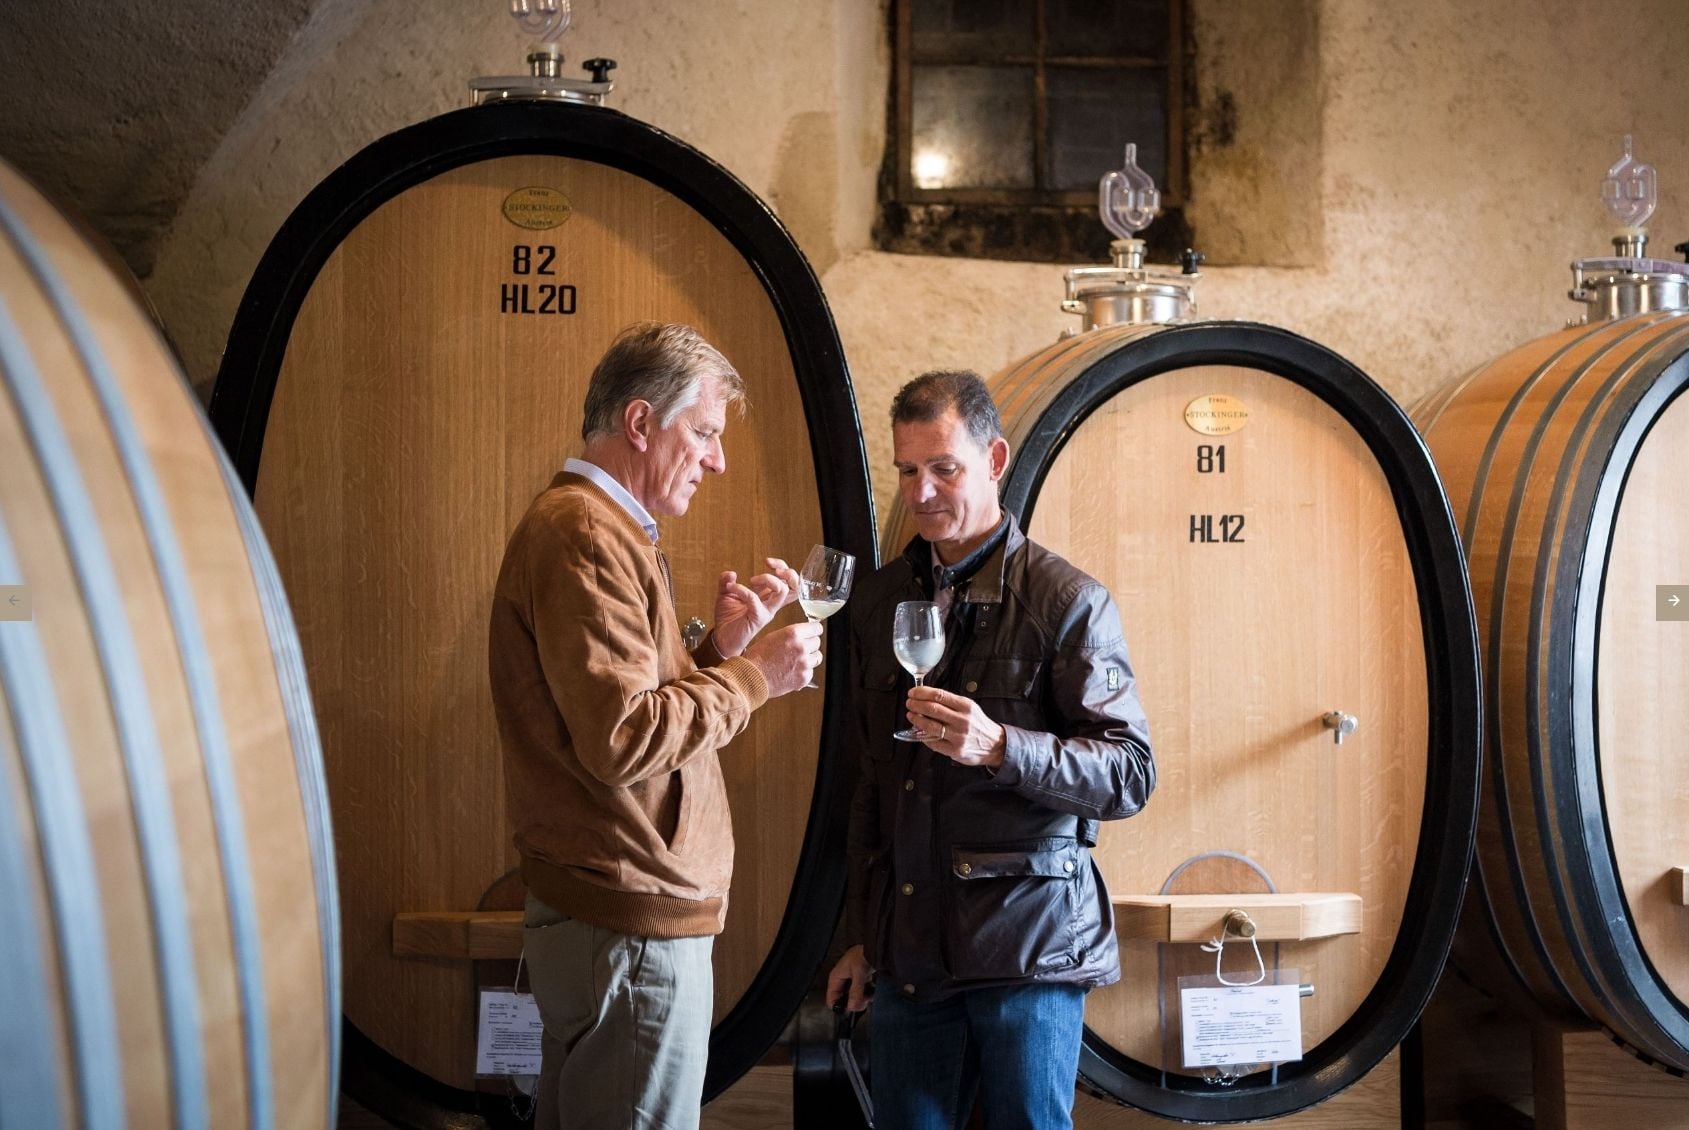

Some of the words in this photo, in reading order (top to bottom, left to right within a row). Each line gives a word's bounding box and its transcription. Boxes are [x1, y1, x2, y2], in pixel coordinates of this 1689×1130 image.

[501, 284, 577, 314] HL20
[1190, 410, 1246, 418] STOCKINGER
[1197, 445, 1226, 473] 81
[1189, 514, 1245, 543] HL12
